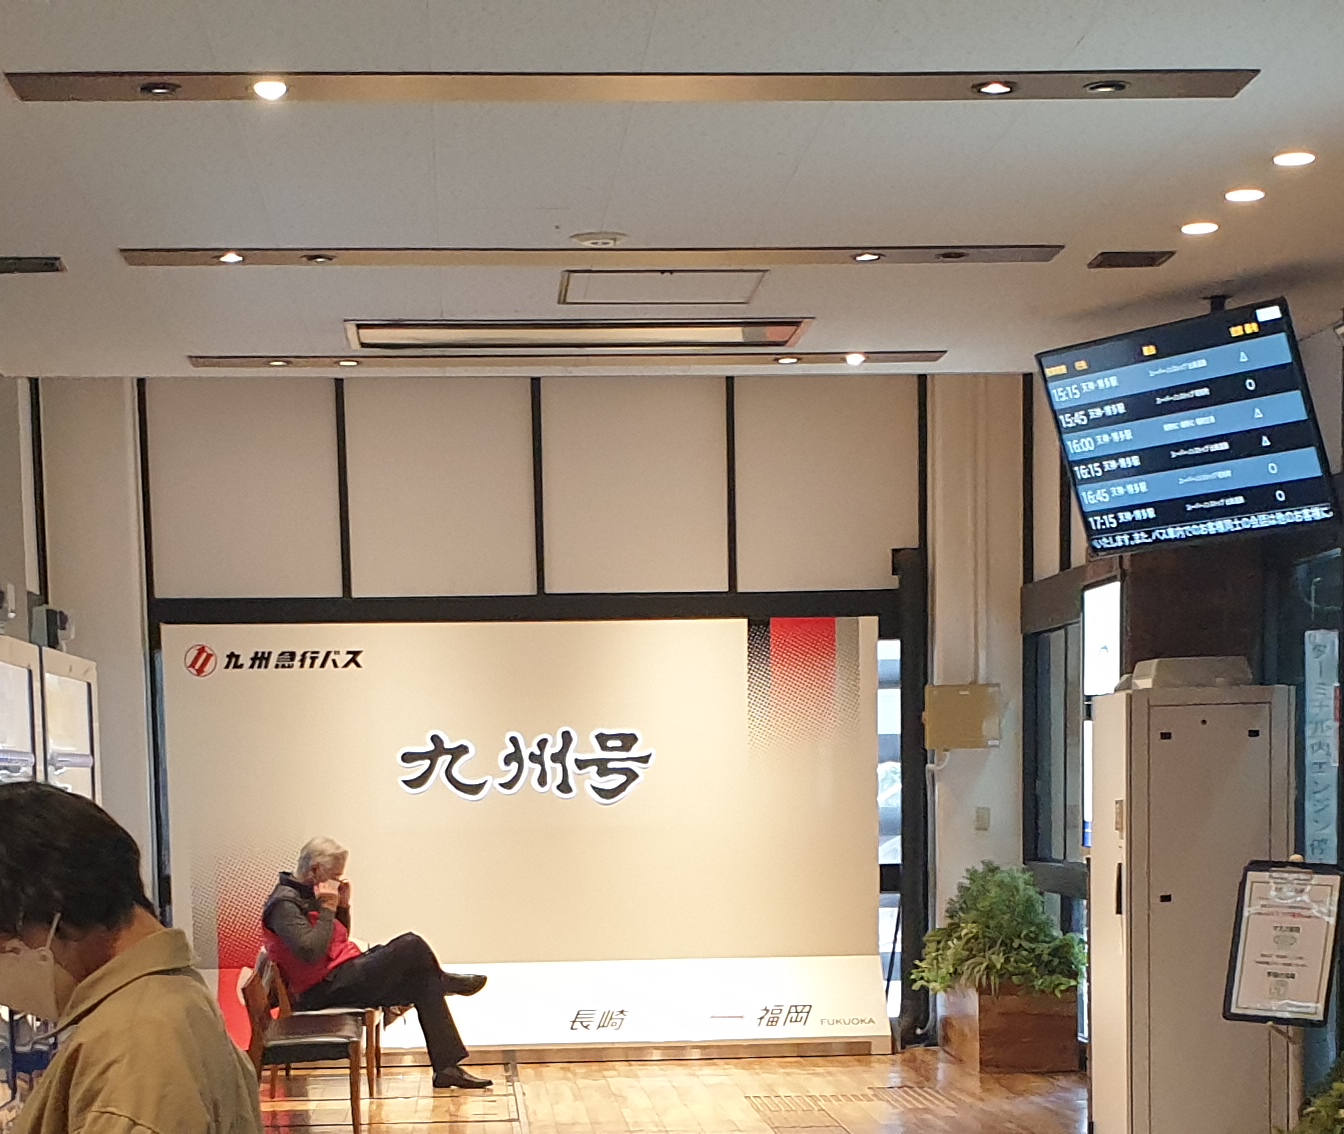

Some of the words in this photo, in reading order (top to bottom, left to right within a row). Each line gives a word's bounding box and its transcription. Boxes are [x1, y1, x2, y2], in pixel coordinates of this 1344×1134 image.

[1052, 385, 1080, 401] 15:15
[1059, 410, 1088, 428] 15:45
[1066, 437, 1095, 453] 16:00
[1073, 462, 1103, 479] 16:15
[1081, 488, 1110, 504] 16:45
[1088, 514, 1117, 530] 17:15
[223, 650, 364, 670] 九州急行バス
[1309, 643, 1332, 863] ターミナル内エンジン停
[399, 728, 654, 802] 九州号
[569, 1008, 629, 1031] 長崎
[756, 1004, 812, 1027] 福岡
[820, 1017, 876, 1027] FUKUOKA
